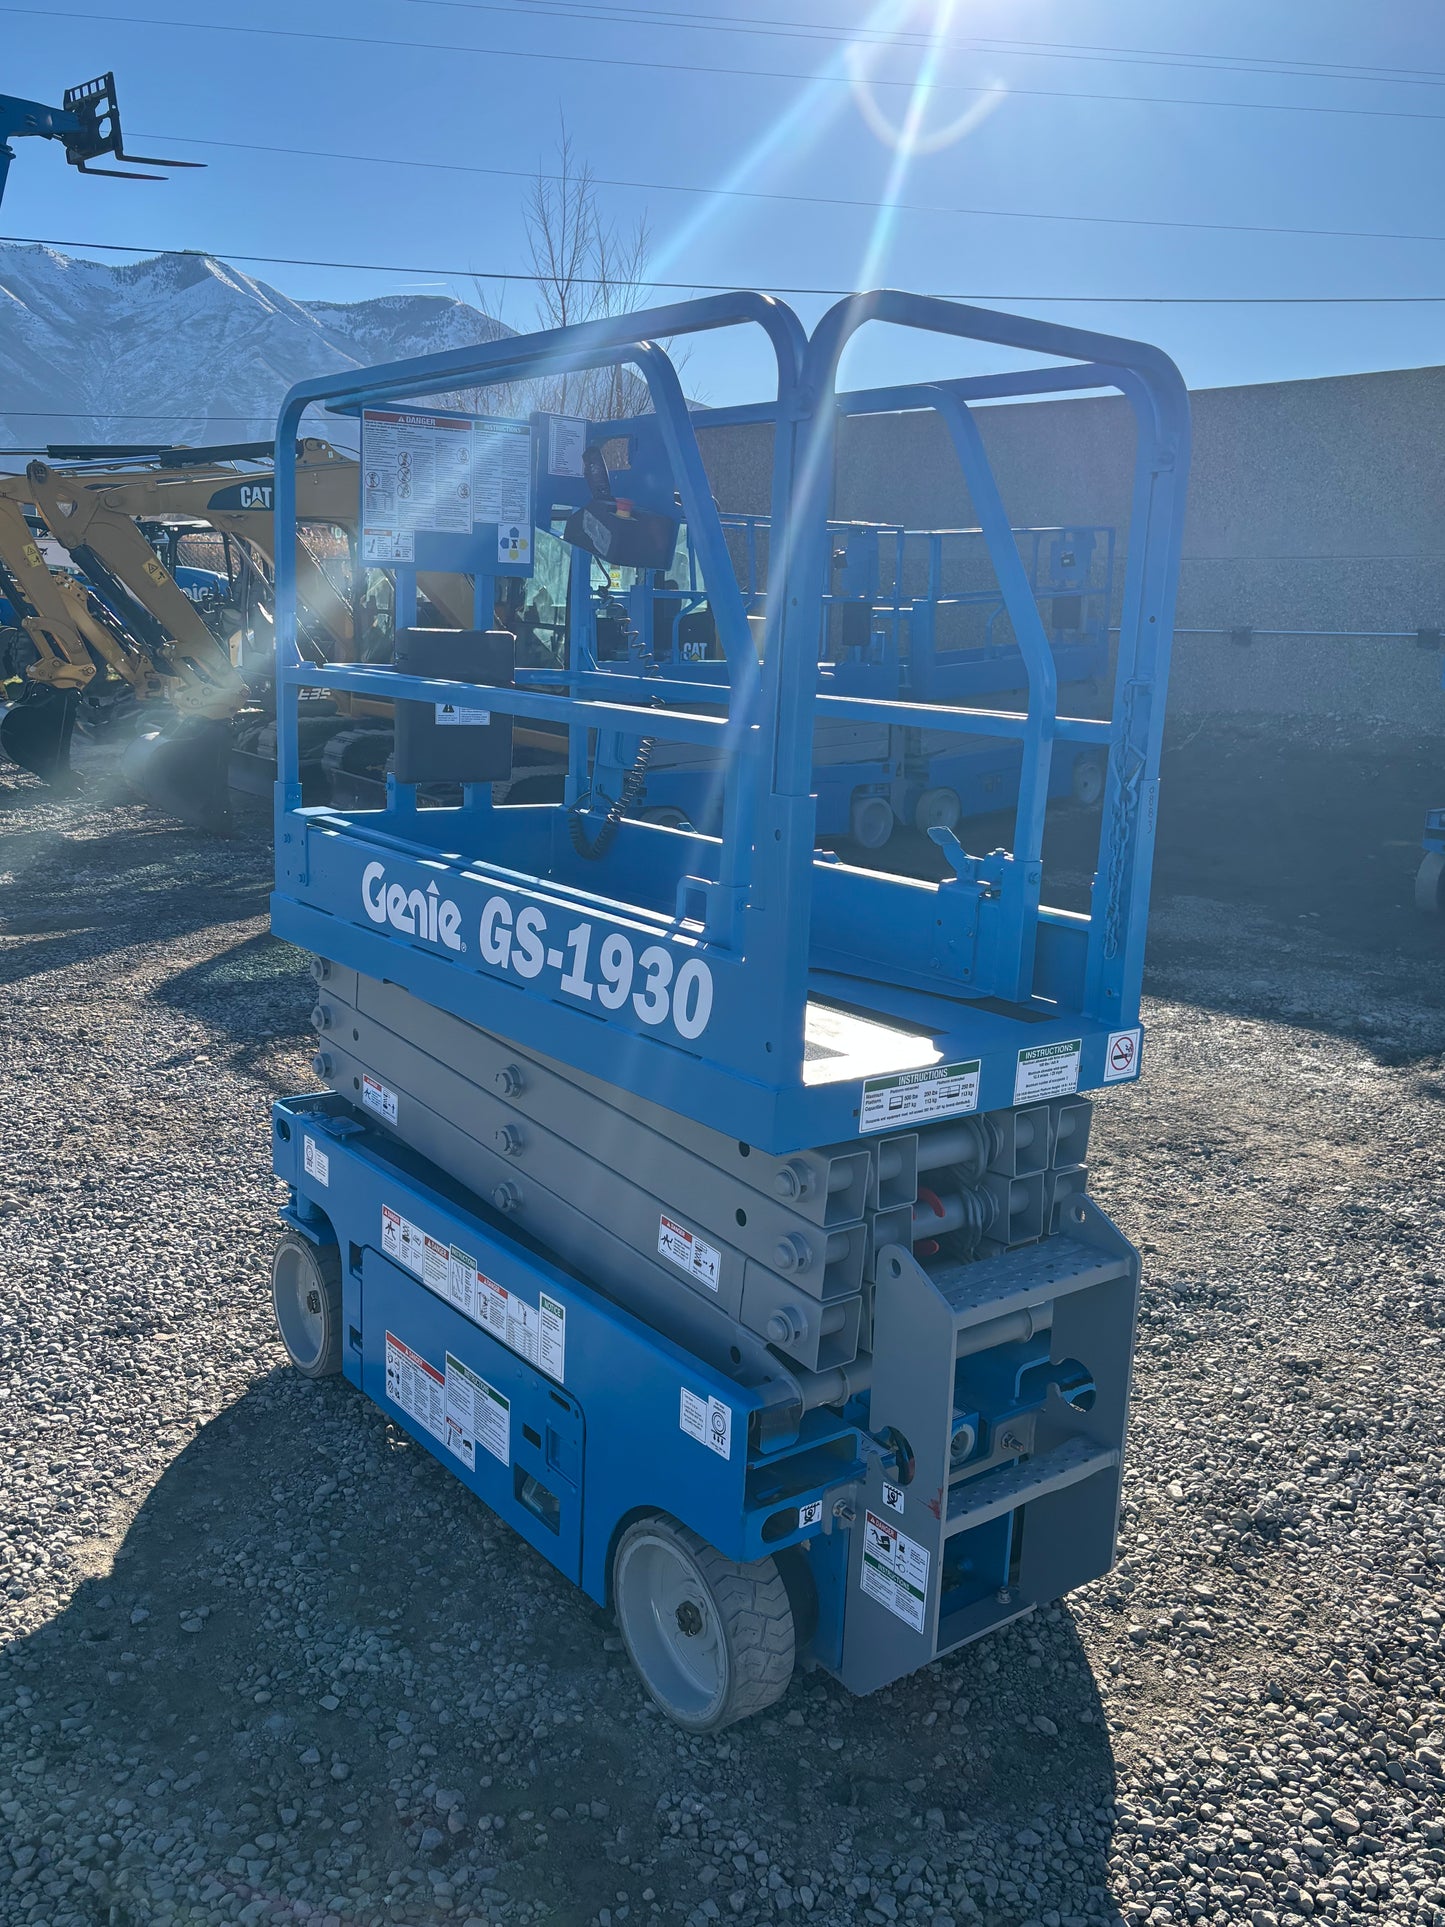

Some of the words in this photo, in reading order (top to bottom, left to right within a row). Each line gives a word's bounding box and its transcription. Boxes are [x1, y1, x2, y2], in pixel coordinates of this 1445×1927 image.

[405, 416, 436, 426] DANGER
[240, 486, 273, 508] CAT
[683, 642, 708, 661] CAT
[361, 861, 463, 951] Genie
[479, 896, 714, 1039] GS-1930
[1025, 1043, 1074, 1060] INSTRUCTIONS
[898, 1068, 948, 1086] INSTRUCTIONS
[431, 1242, 448, 1258] DANGER
[544, 1298, 562, 1318] NOTICE
[875, 1521, 895, 1537] DANGER
[877, 1563, 911, 1591] INSTRUCTIONS
